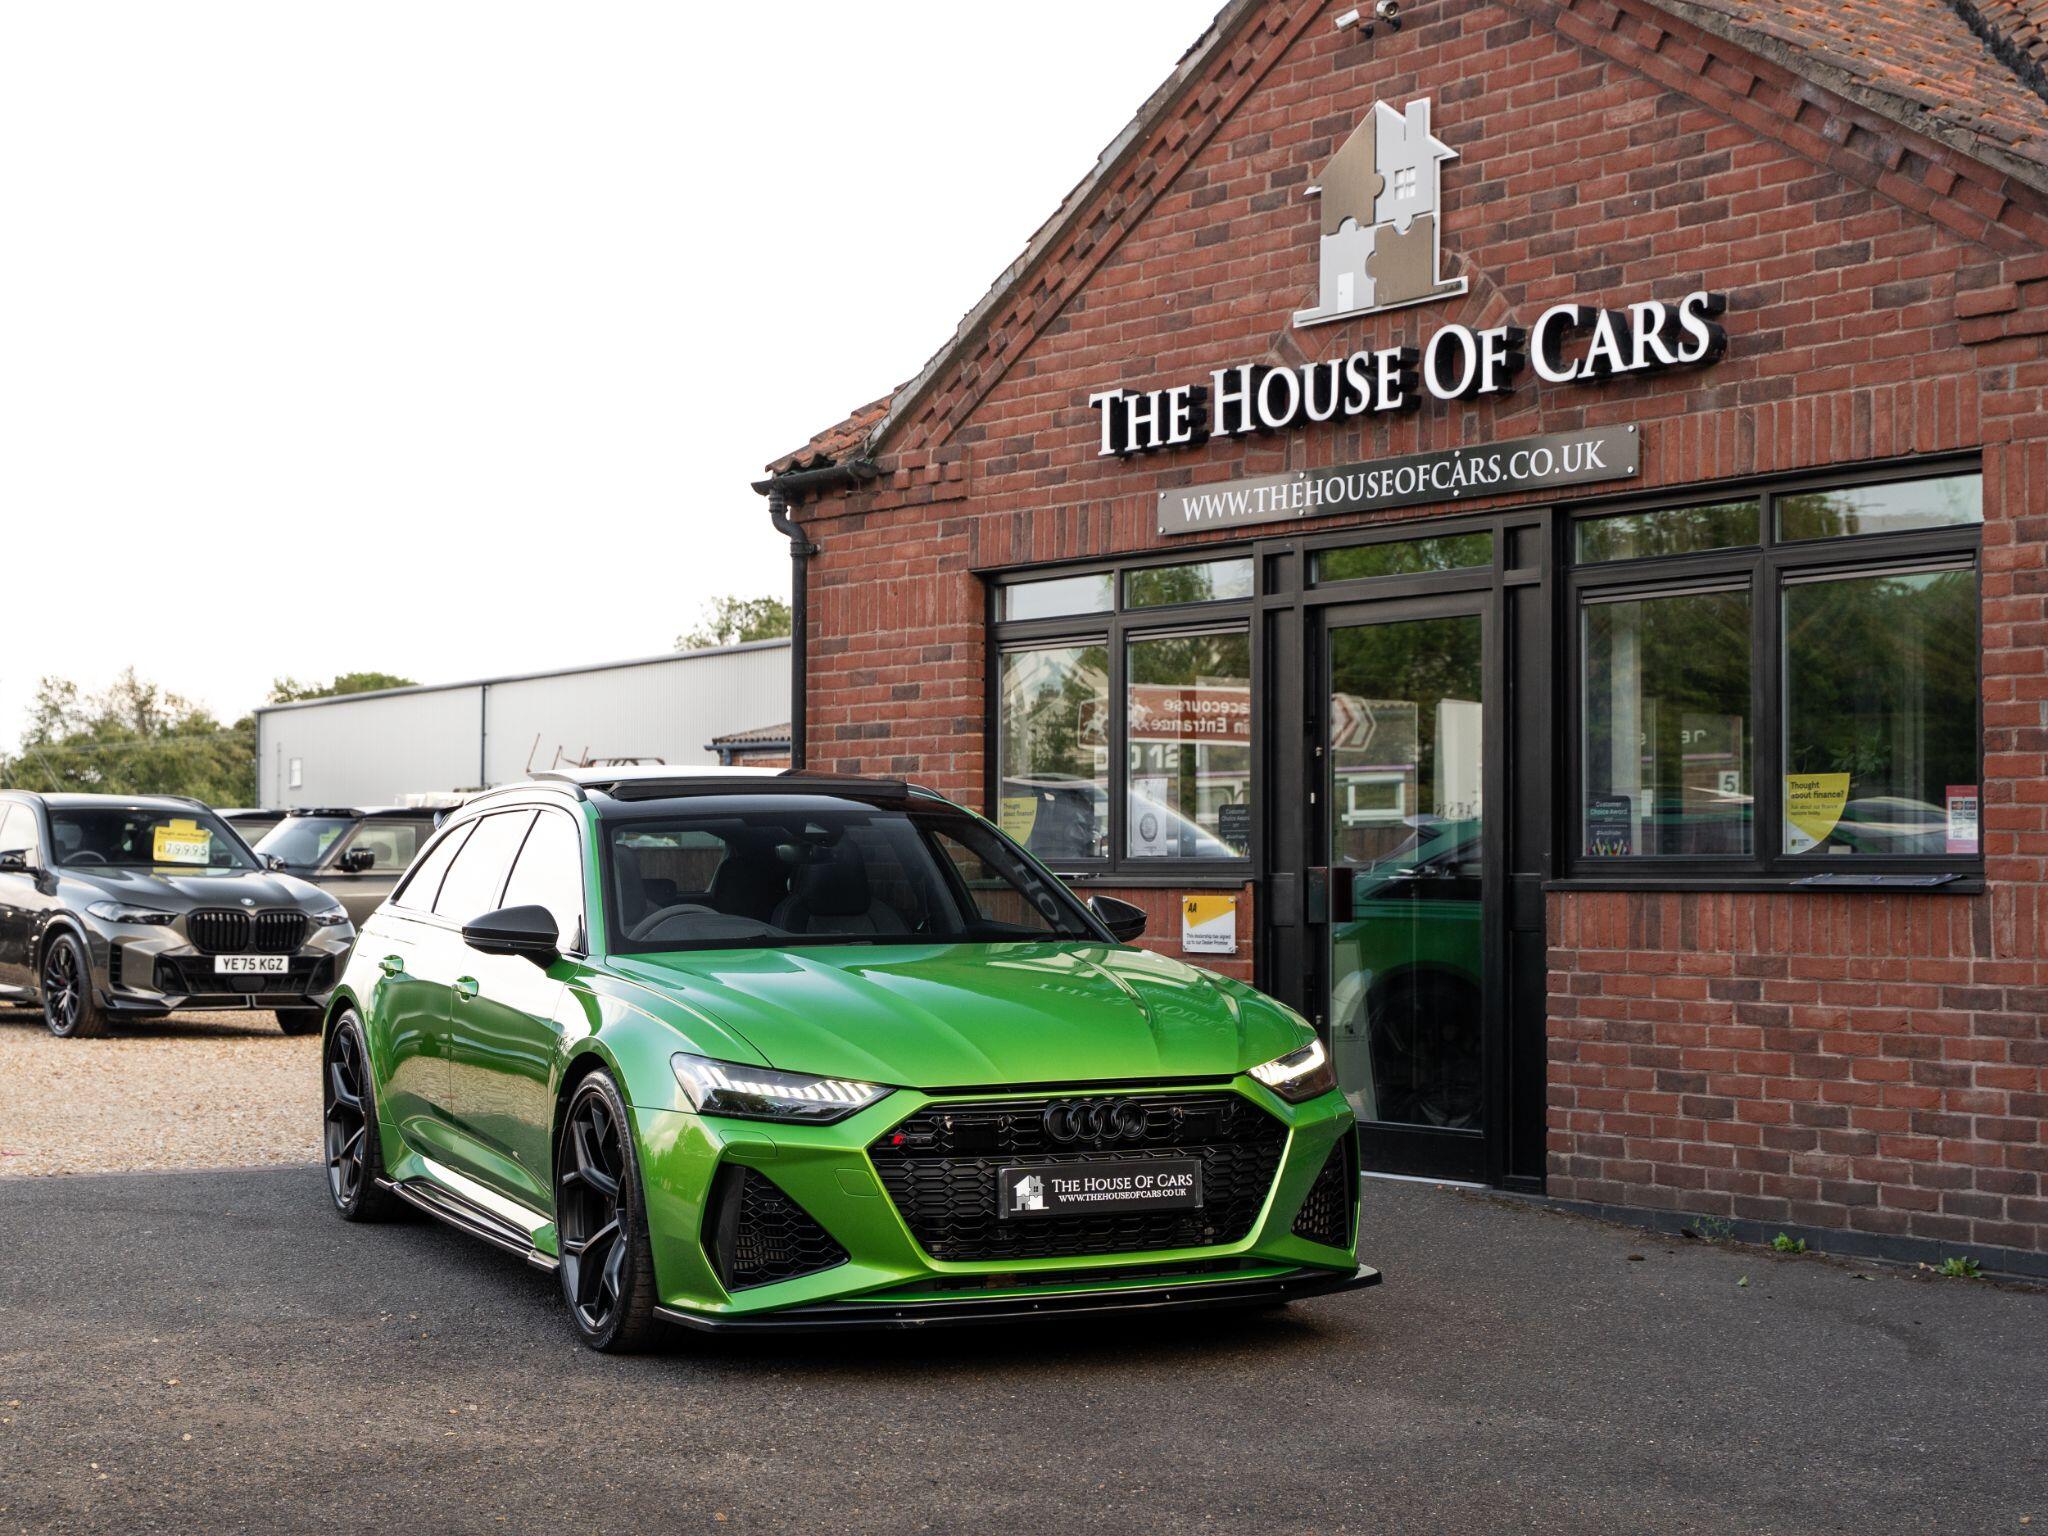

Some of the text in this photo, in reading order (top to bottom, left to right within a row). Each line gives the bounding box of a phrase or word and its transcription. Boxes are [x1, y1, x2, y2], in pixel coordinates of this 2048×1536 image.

[1089, 291, 1710, 456] THE HOUSE OF CARS
[1182, 439, 1606, 522] WWW.THEHOUSEOFCARS.CO.UK
[1791, 781, 1820, 790] Thought
[1813, 790, 1845, 799] finance?
[1188, 902, 1197, 912] AA
[223, 958, 283, 971] YE75 KGZ
[1052, 1173, 1193, 1193] THE HOUSE OF CARS
